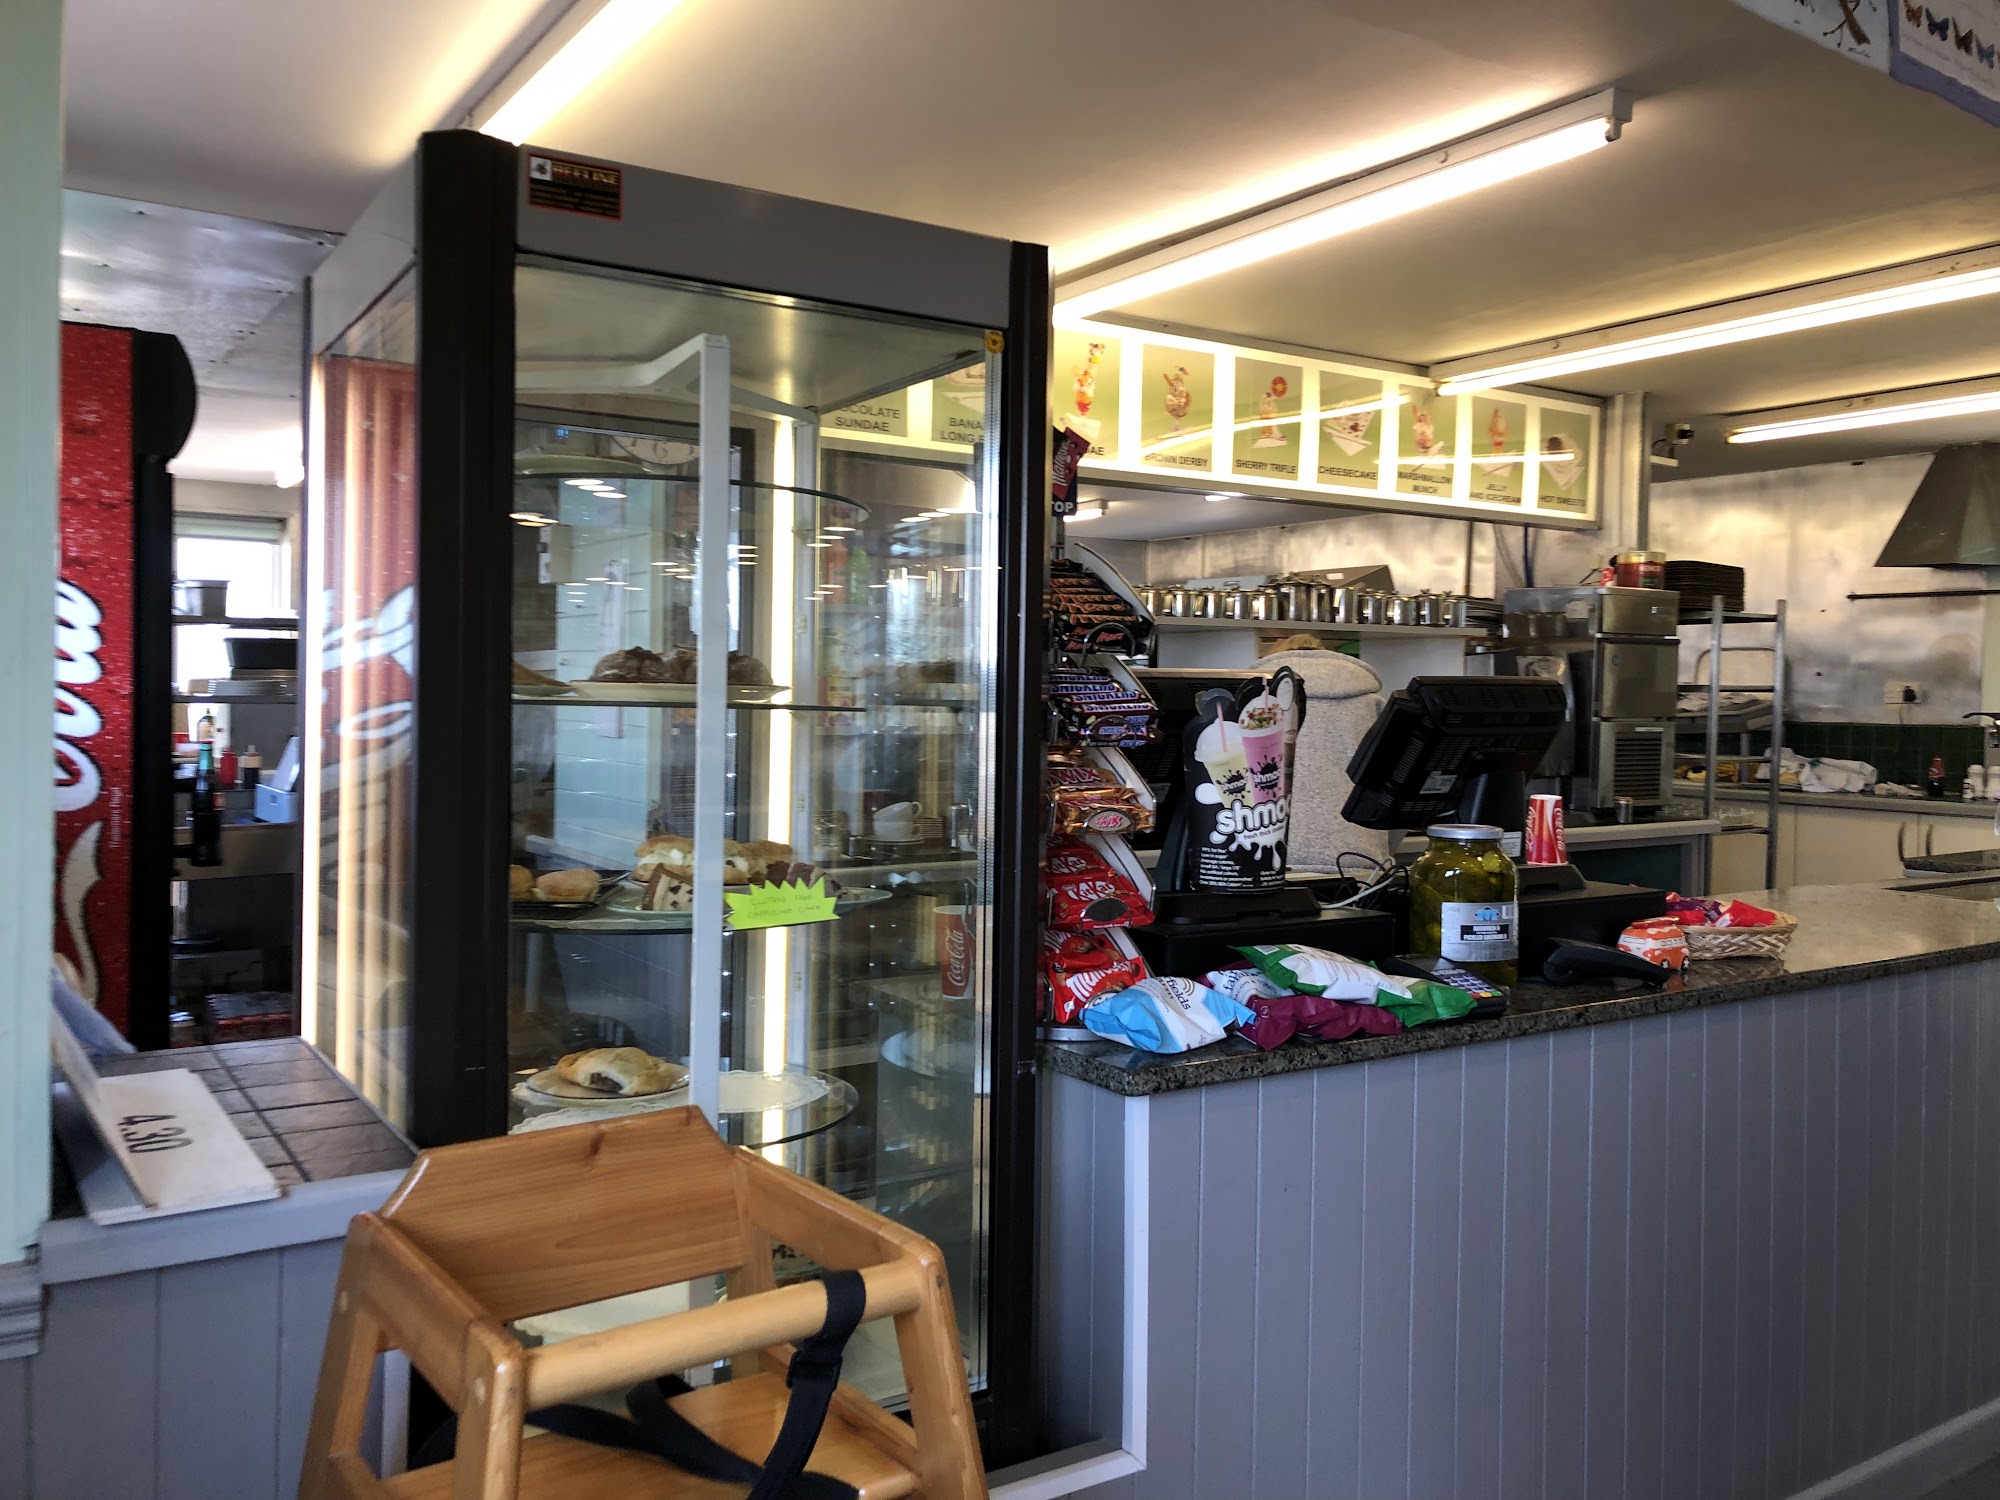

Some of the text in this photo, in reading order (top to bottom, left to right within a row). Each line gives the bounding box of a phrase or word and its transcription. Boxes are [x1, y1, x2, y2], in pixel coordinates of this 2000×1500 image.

[841, 404, 901, 419] COLATE
[835, 416, 890, 432] SUNDAE
[948, 417, 984, 430] BANA
[940, 430, 976, 443] LONG
[1235, 459, 1297, 474] SHERRY TRIFLE
[1318, 465, 1378, 481] CHEESECAKE
[1164, 977, 1191, 1010] fields
[117, 1113, 194, 1154] 4.30
